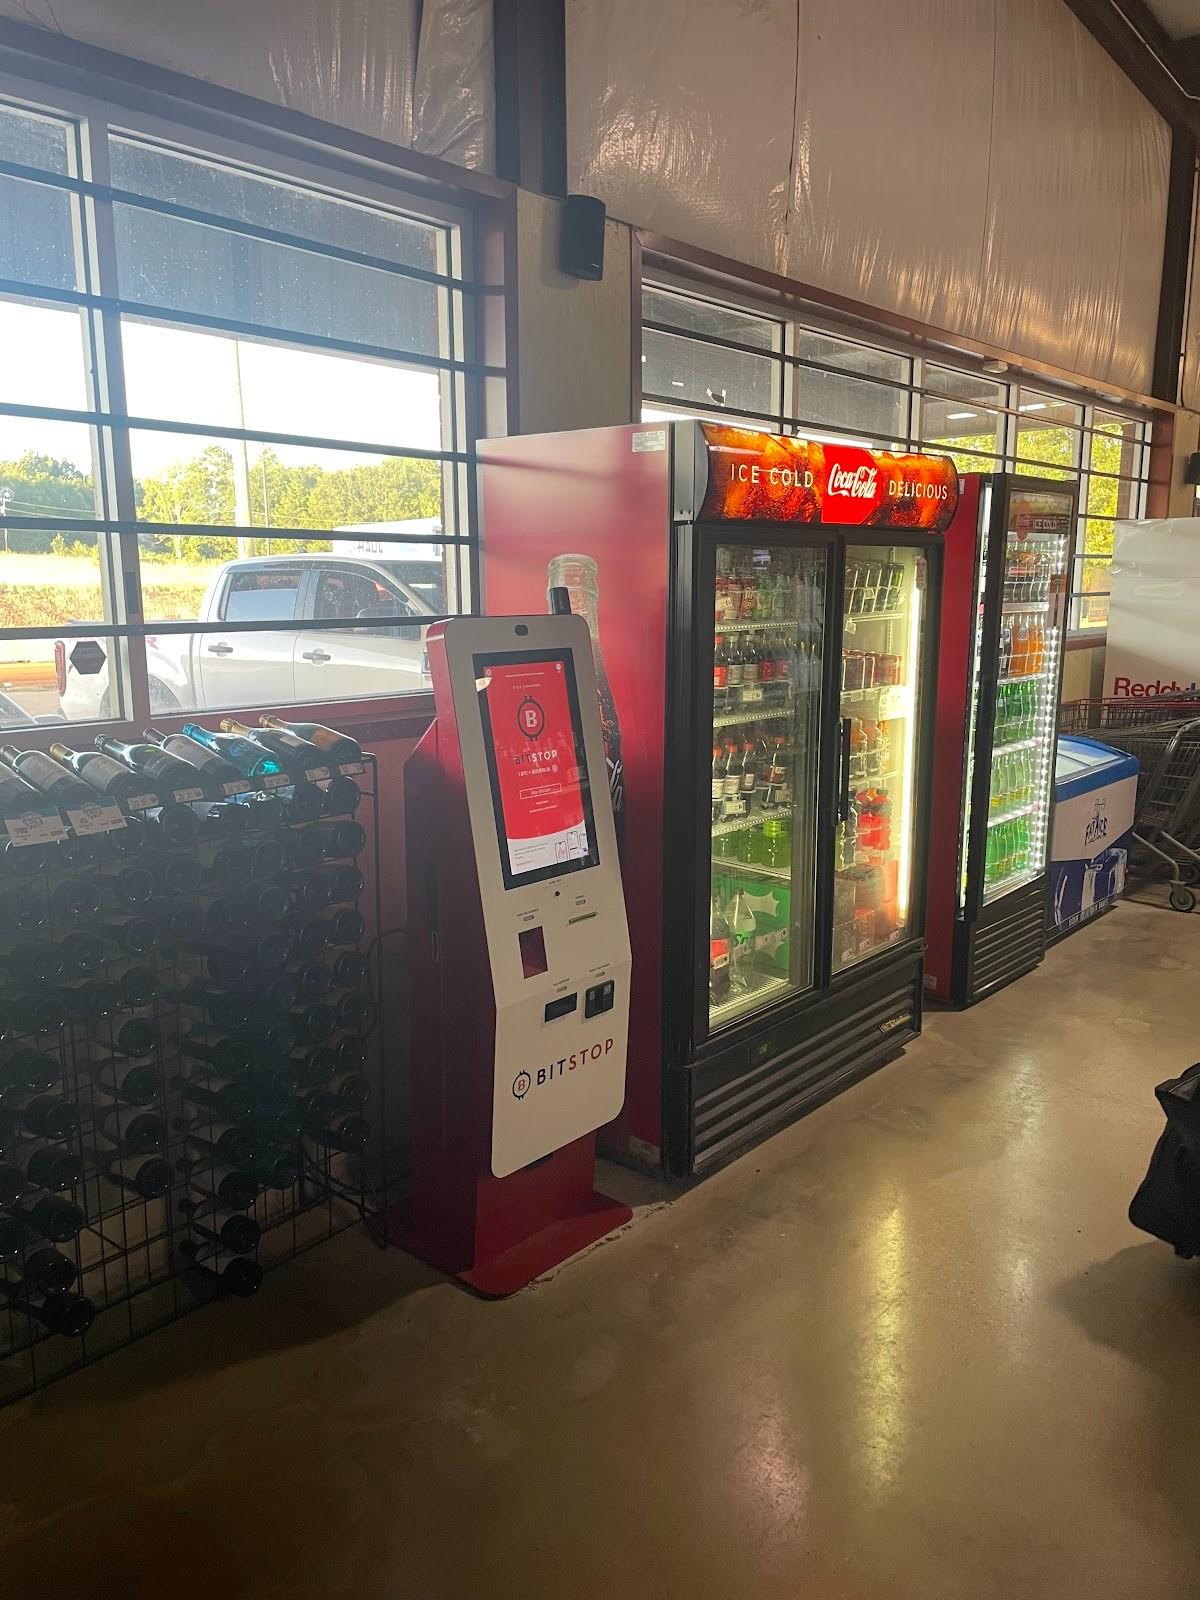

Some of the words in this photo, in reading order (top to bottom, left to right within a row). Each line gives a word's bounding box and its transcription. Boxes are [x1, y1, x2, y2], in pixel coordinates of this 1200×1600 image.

[731, 463, 760, 485] ICE
[769, 468, 814, 488] COLD
[888, 479, 948, 500] DELICIOUS
[1043, 519, 1057, 530] COLD
[1113, 676, 1190, 697] Redd
[536, 1038, 614, 1086] BITSTOP
